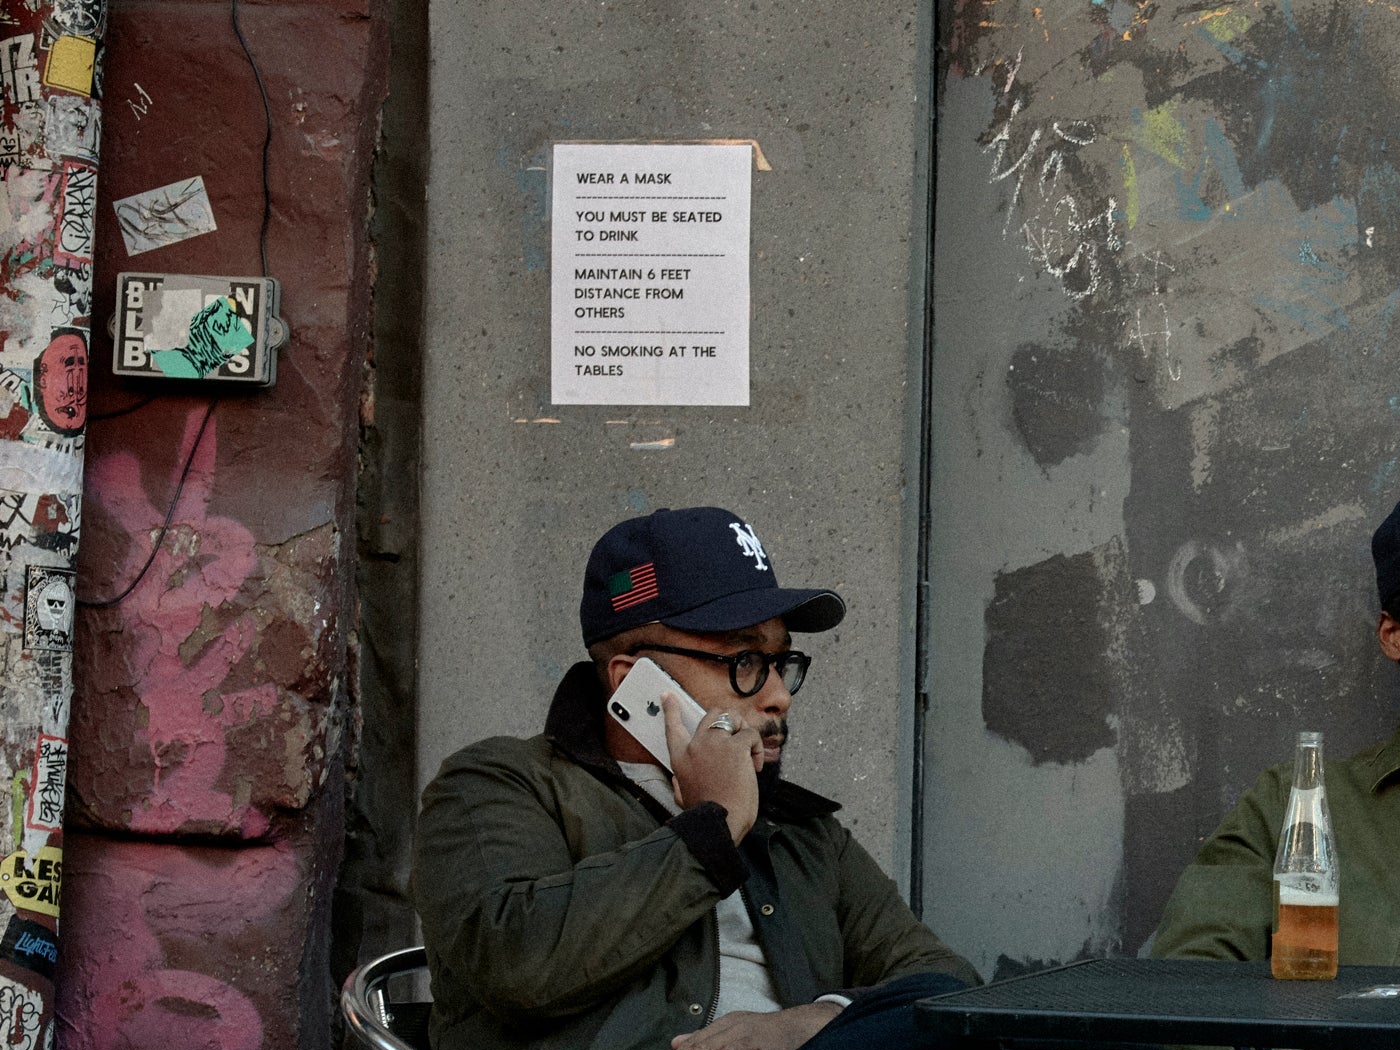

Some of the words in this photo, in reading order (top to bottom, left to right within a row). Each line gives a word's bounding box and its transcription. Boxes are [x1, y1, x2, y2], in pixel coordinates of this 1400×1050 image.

[576, 172, 615, 184] WEAR
[619, 173, 630, 185] A
[634, 173, 672, 185] MASK
[575, 211, 605, 223] YOU
[609, 211, 647, 223] MUST
[651, 211, 668, 223] BE
[672, 211, 723, 223] SEATED
[575, 230, 595, 242] TO
[599, 230, 639, 242] DRINK
[574, 268, 643, 280] MAINTAIN
[647, 268, 656, 280] 6
[660, 268, 691, 280] FEET
[574, 287, 641, 300] DISTANCE
[645, 288, 684, 300] FROM
[574, 306, 625, 319] OTHERS
[574, 345, 596, 357] NO
[601, 345, 664, 358] SMOKING
[668, 345, 687, 358] AT
[691, 346, 717, 358] THE
[574, 364, 624, 377] TABLES
